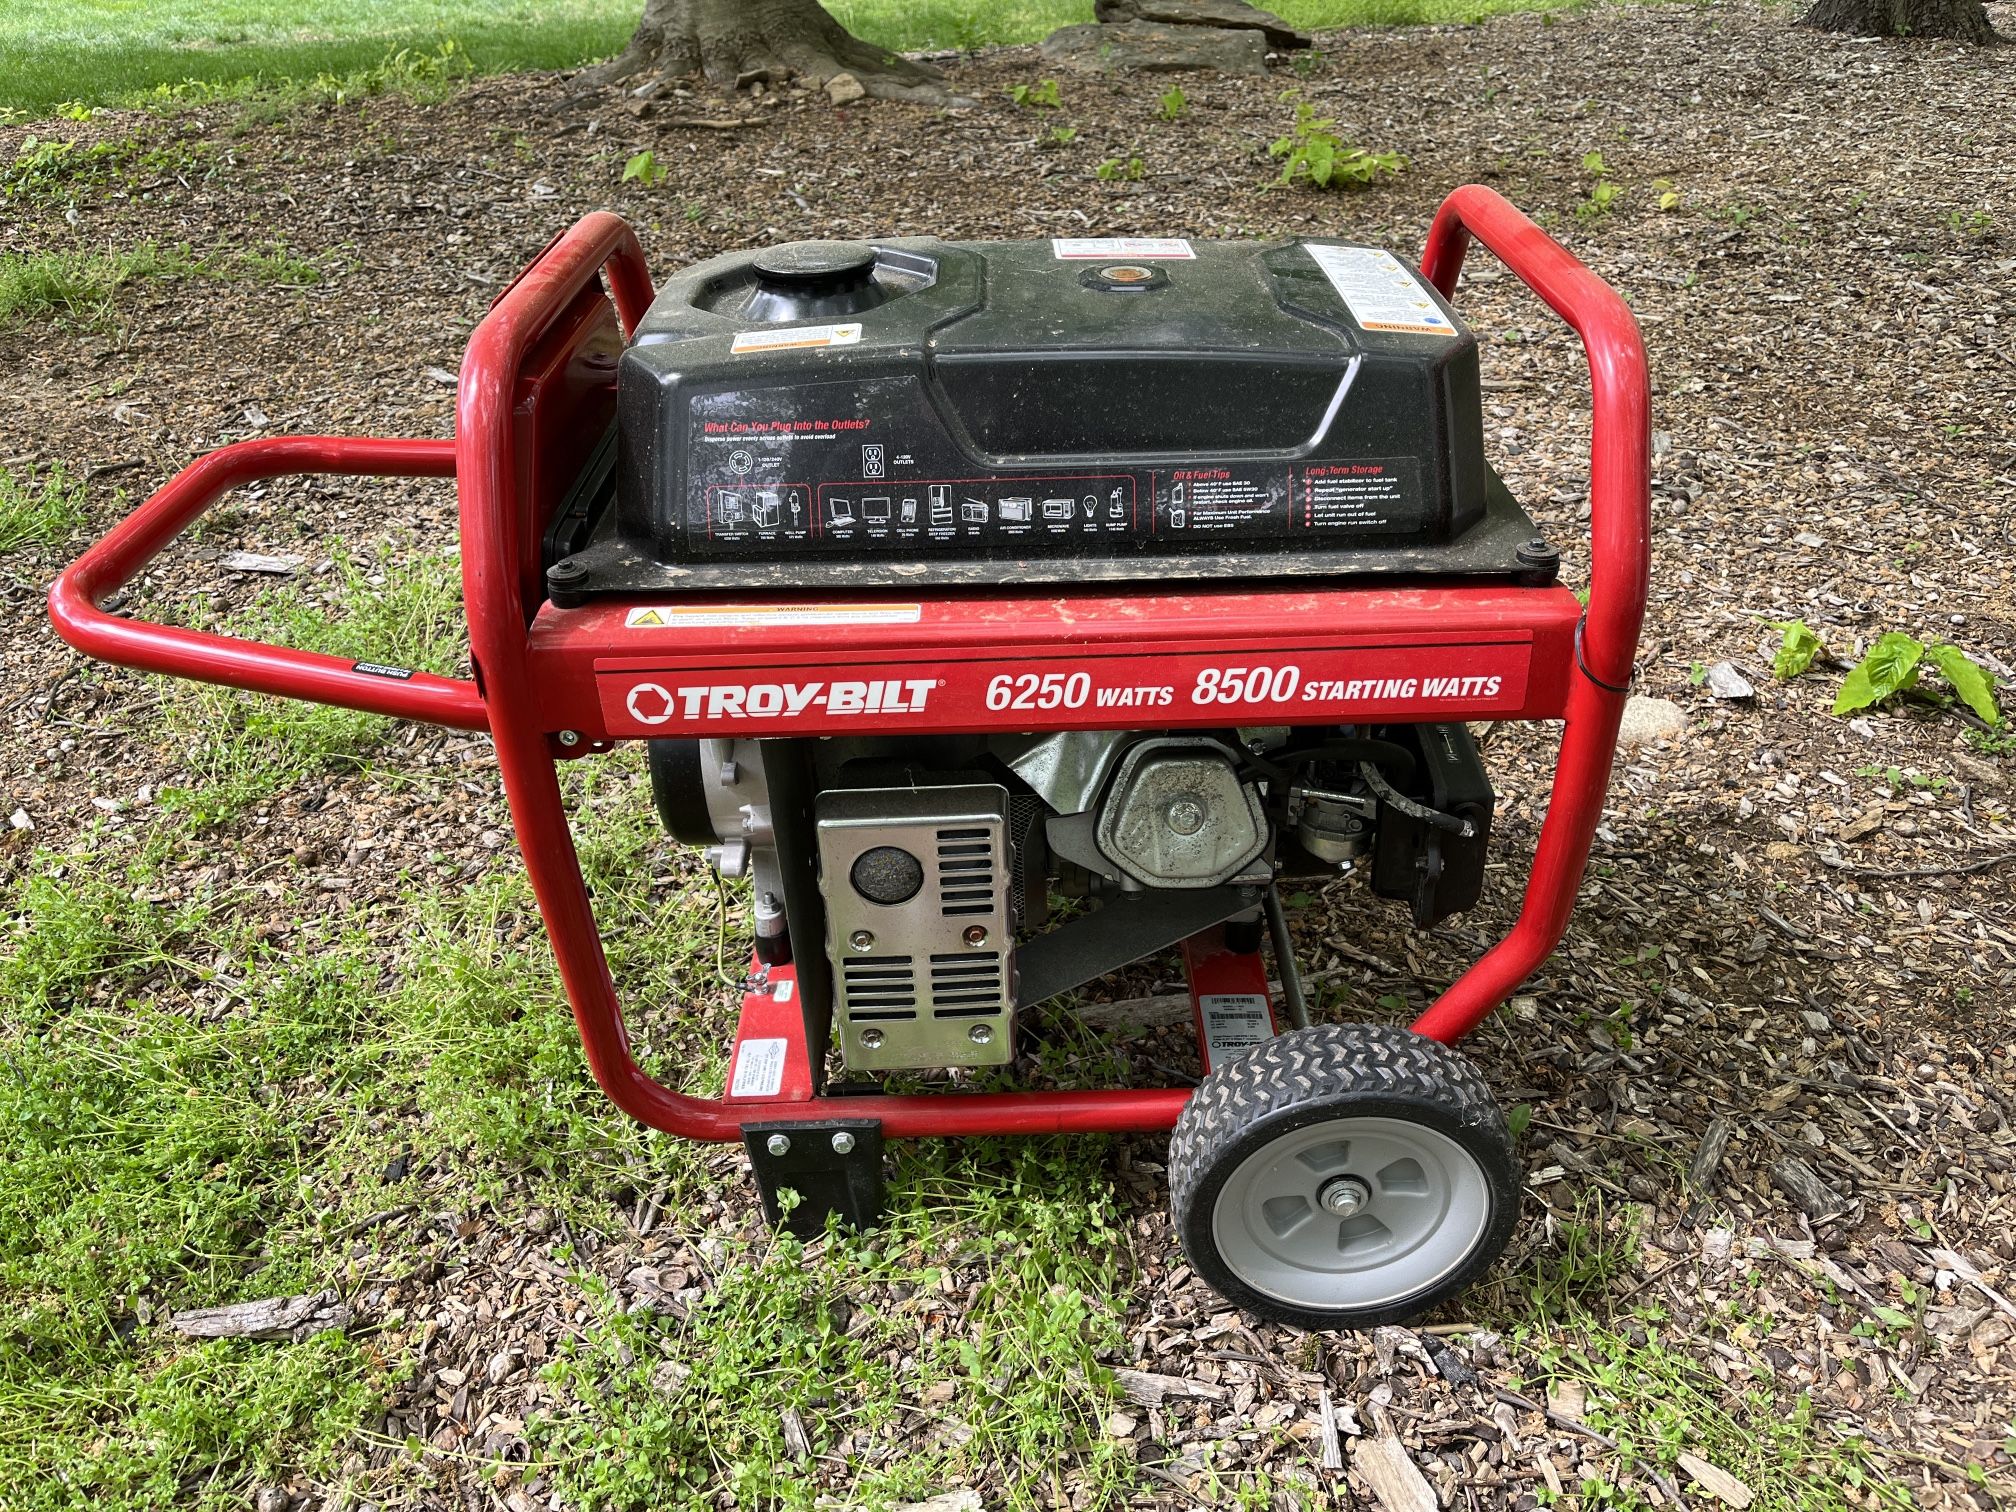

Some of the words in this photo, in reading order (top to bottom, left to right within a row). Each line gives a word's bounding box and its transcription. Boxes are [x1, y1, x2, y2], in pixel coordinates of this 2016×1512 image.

[704, 421, 728, 433] What
[730, 421, 748, 432] Can
[752, 421, 768, 431] You
[771, 420, 791, 432] Plug
[794, 420, 812, 431] Into
[814, 420, 829, 430] the
[832, 419, 870, 430] Outlets?
[1174, 471, 1184, 480] Oil
[1306, 466, 1349, 476] Long-Term
[1351, 465, 1383, 475] Storage
[356, 665, 387, 674] BUTTON
[985, 672, 1091, 710] 6250
[1097, 686, 1174, 707] WATTS
[1192, 665, 1300, 706] 8500
[1302, 676, 1417, 701] STARTING
[1421, 676, 1501, 697] WATTS
